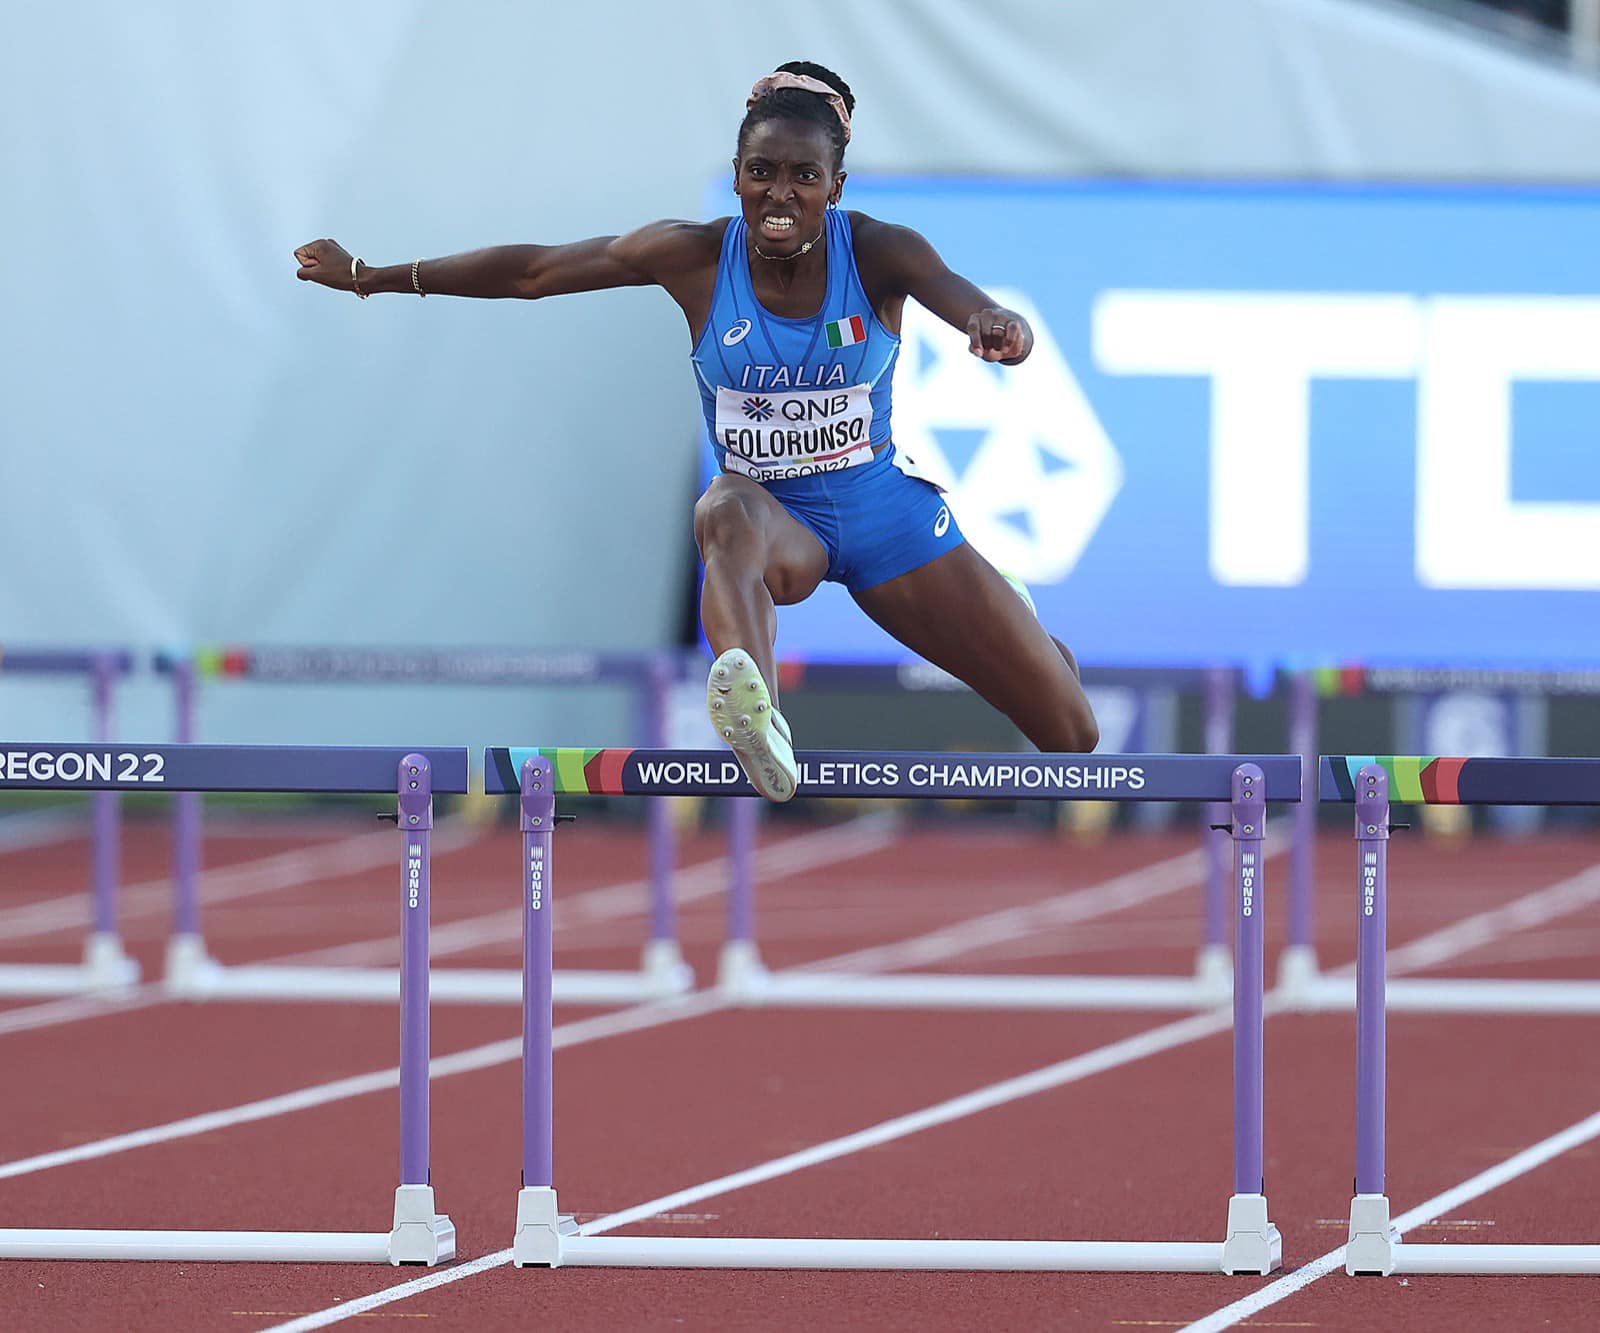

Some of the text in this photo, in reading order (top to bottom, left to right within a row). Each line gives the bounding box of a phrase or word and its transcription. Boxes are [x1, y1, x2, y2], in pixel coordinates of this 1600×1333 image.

[741, 364, 846, 388] ITALIA
[781, 395, 849, 421] QNB
[724, 418, 864, 458] FOLORUNSO
[637, 762, 740, 786] WORLD
[747, 763, 899, 786] LETICS
[908, 764, 1145, 790] CHAMPIONSHIPS
[408, 858, 421, 909] MONDO
[530, 860, 543, 911] MONDO
[1242, 867, 1255, 917] MONDO
[1364, 866, 1376, 917] MONDO
